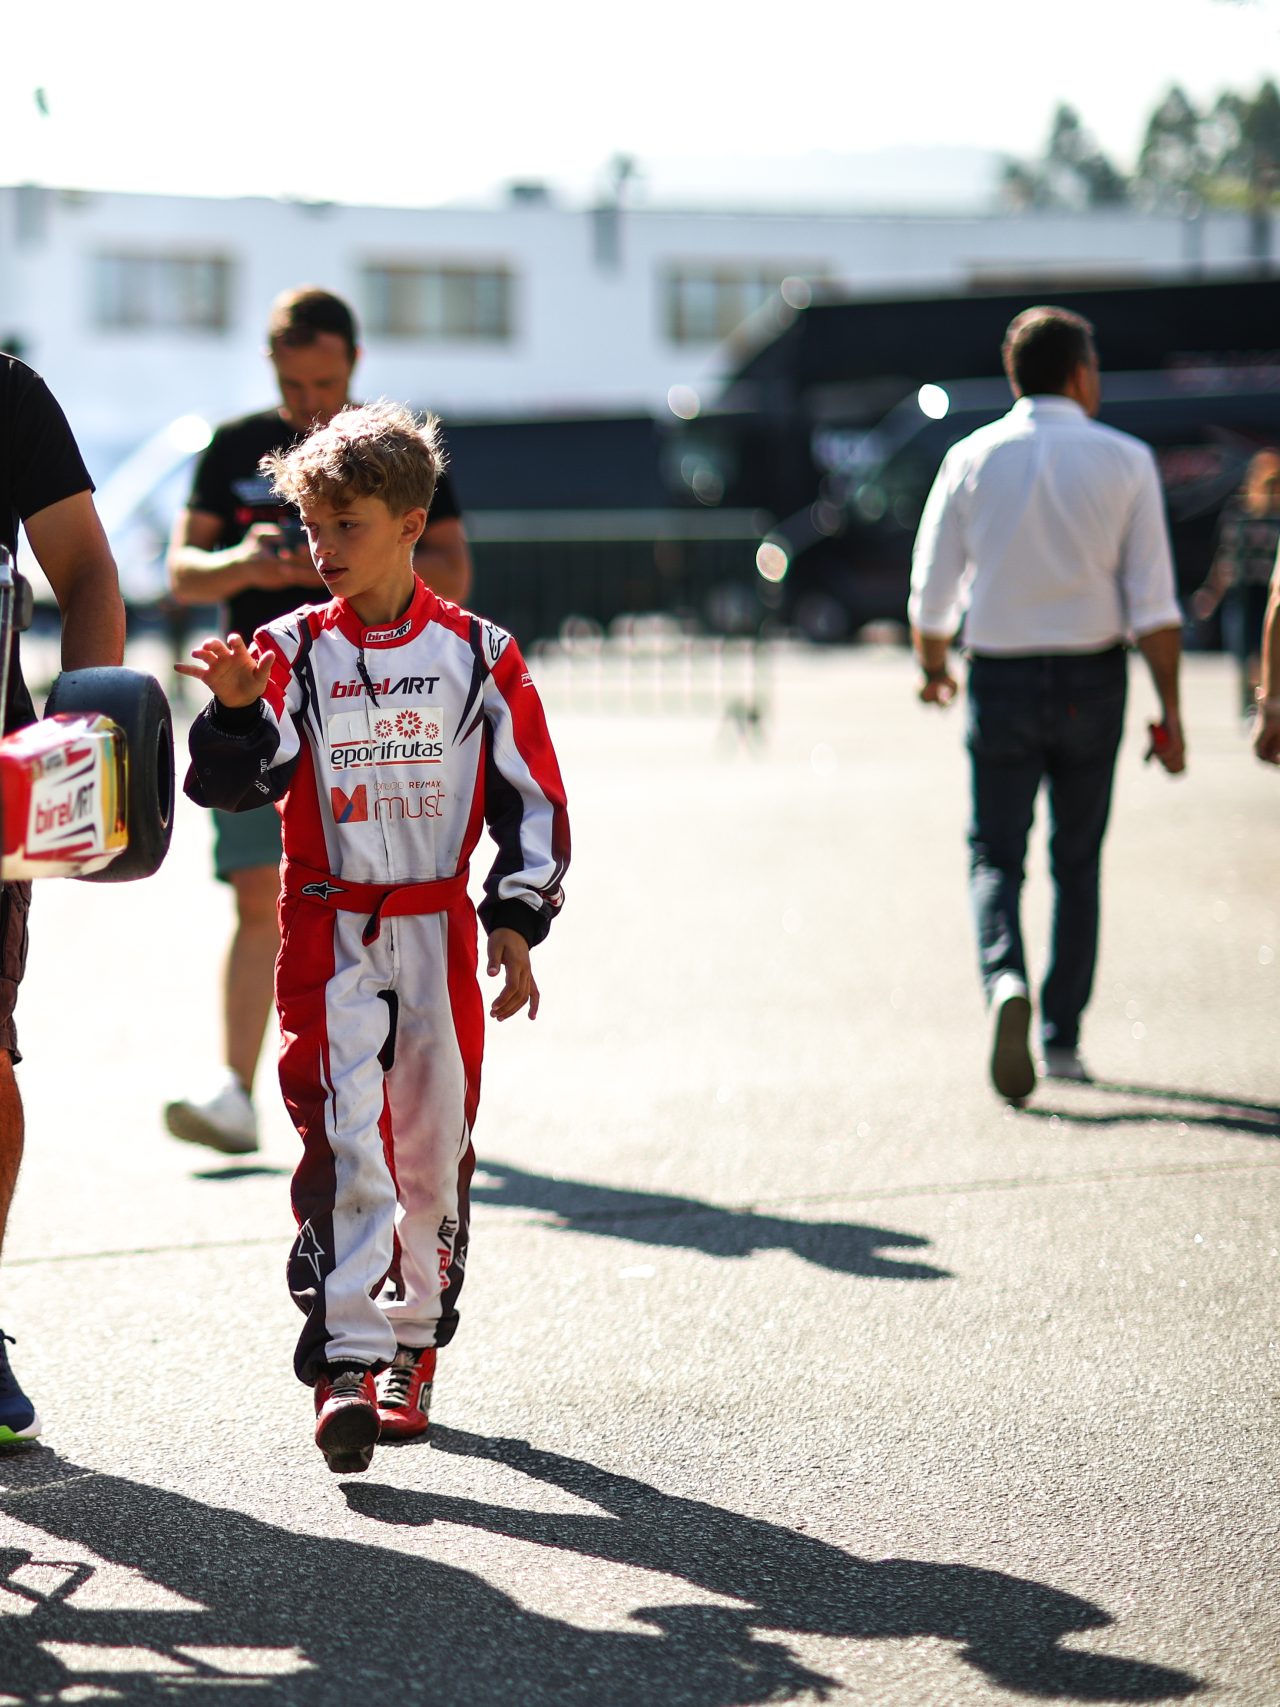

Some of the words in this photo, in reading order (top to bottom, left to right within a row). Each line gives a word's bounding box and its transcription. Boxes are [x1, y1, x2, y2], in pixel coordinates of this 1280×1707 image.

[366, 620, 411, 641] birelART
[330, 676, 440, 699] birelART
[330, 741, 443, 768] eporifrutas
[408, 780, 442, 790] RE/MAX
[35, 782, 95, 835] birelART
[373, 789, 446, 821] must
